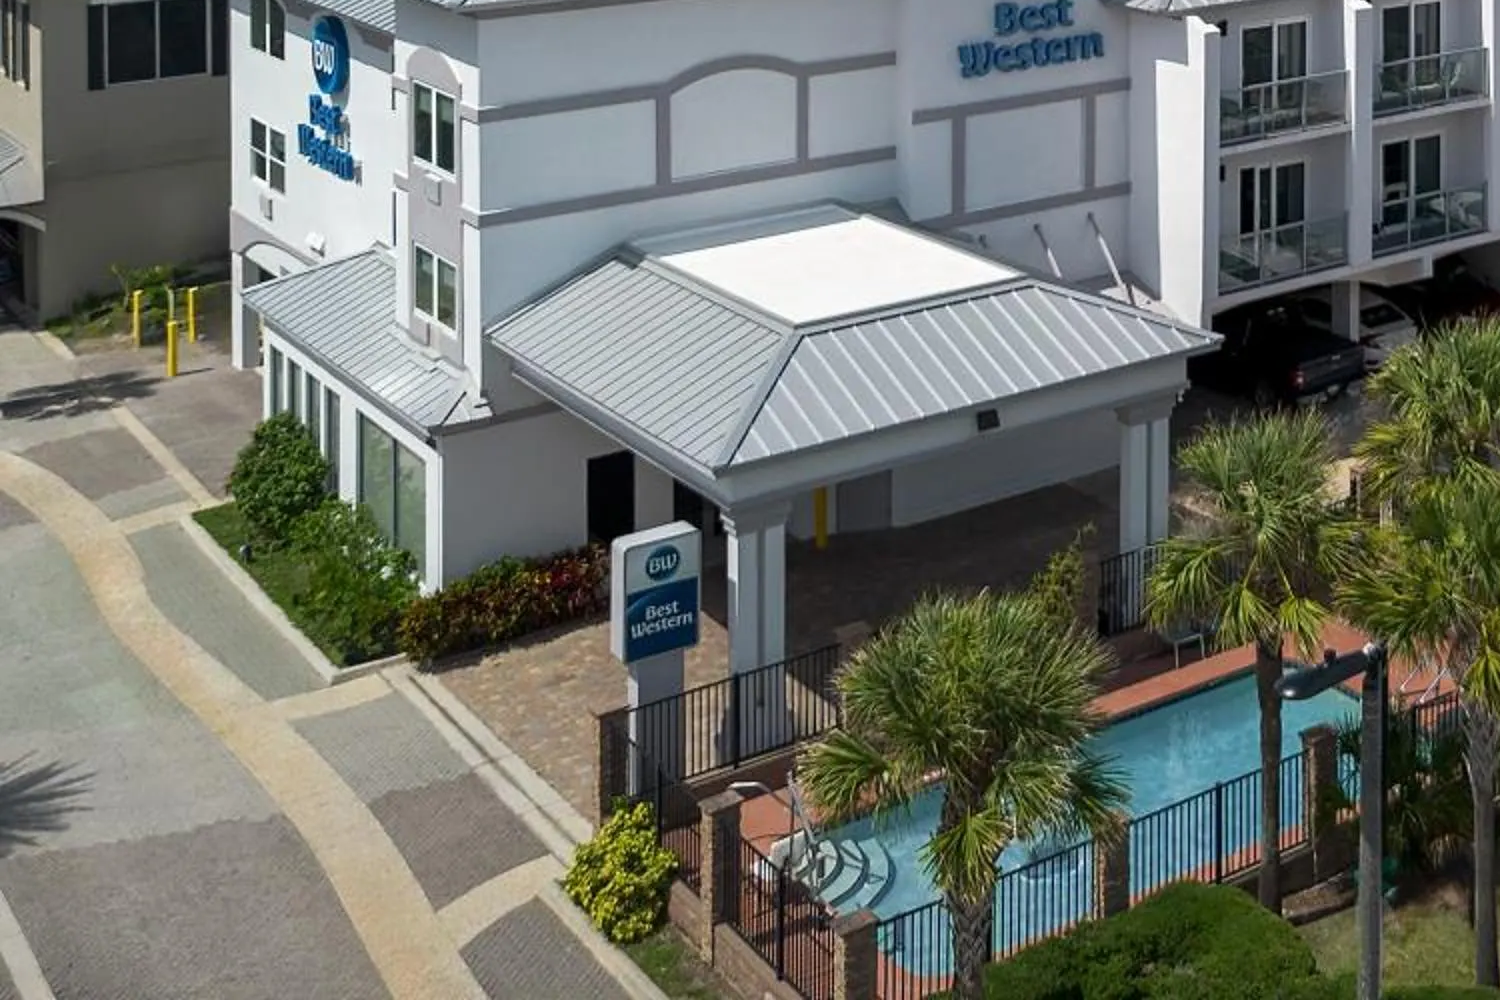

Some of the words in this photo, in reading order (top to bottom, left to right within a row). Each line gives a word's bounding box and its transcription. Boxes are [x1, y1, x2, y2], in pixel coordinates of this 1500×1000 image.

[314, 39, 335, 75] BW
[958, 32, 1104, 78] Western
[648, 553, 677, 574] BW
[645, 600, 679, 620] Best
[631, 611, 693, 639] Western
